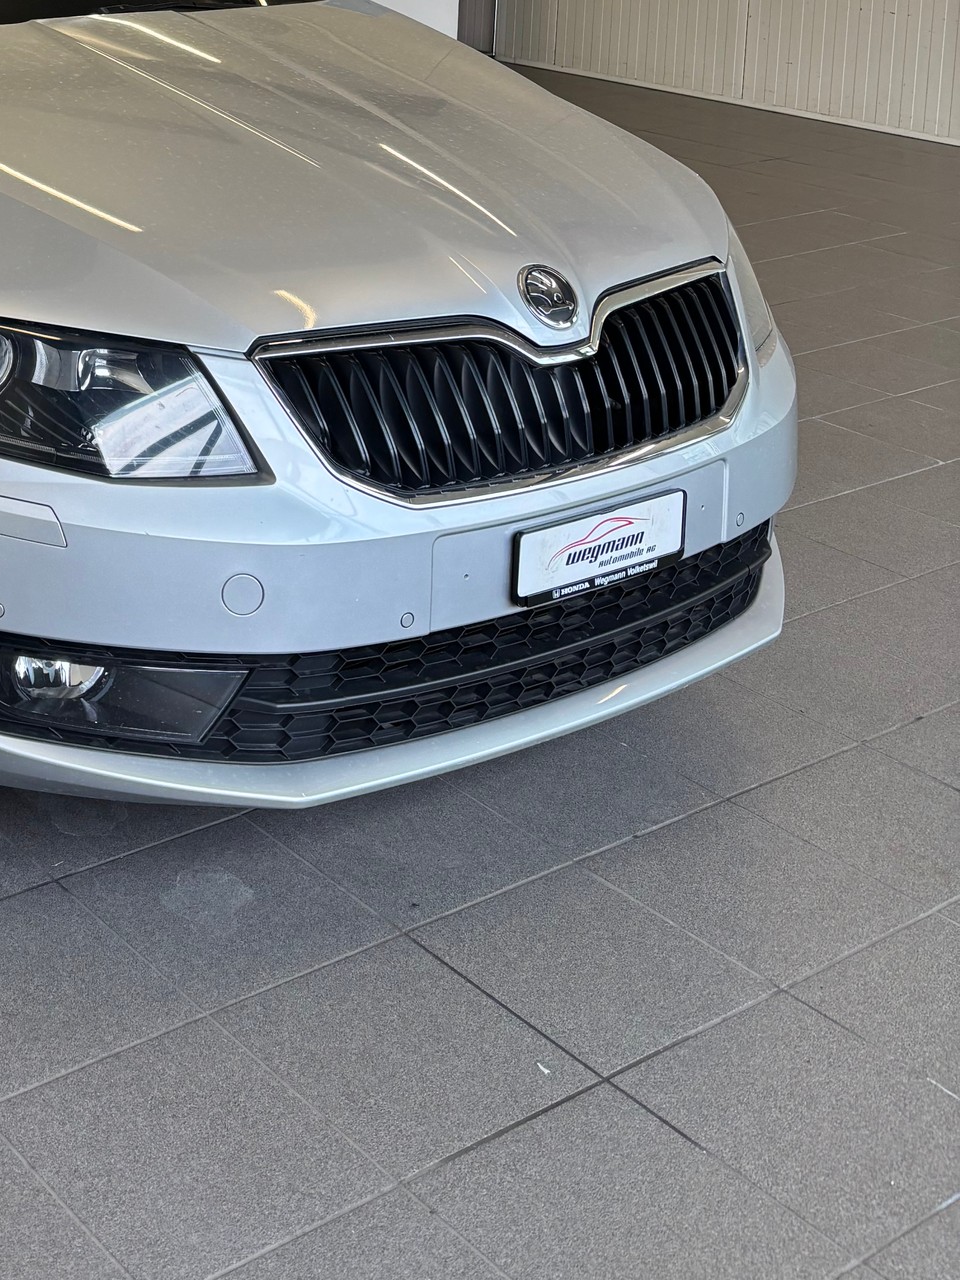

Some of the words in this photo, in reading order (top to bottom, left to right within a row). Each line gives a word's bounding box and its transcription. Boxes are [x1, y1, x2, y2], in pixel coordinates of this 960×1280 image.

[565, 531, 645, 566] wegmann
[560, 581, 591, 596] HONDA
[594, 570, 626, 587] Wegmann
